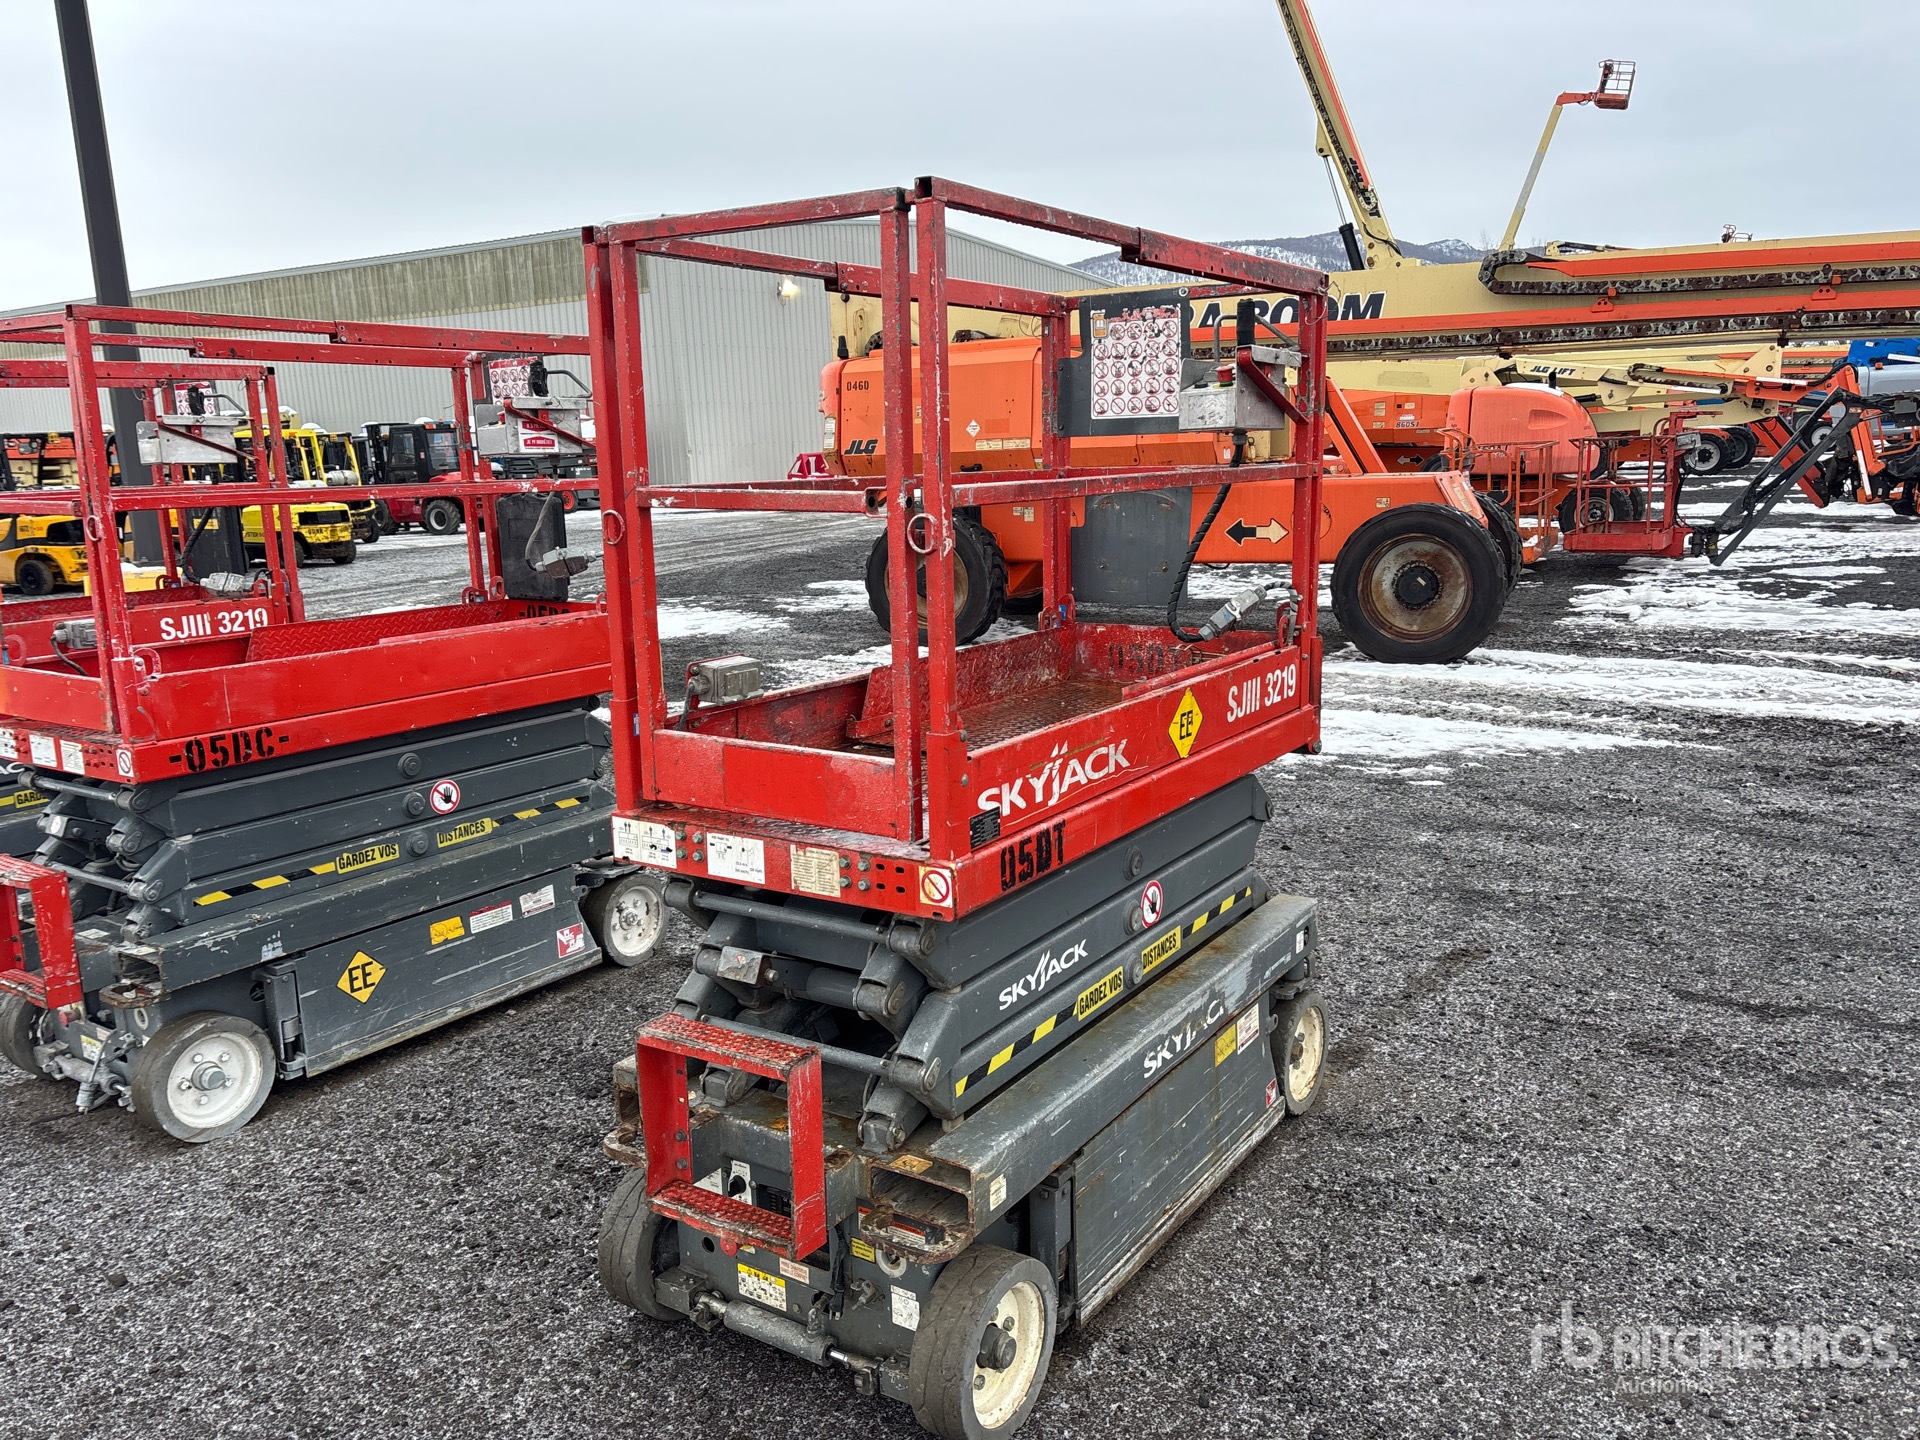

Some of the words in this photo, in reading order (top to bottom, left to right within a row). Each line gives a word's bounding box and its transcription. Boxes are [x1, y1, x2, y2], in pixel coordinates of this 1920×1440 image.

[844, 439, 879, 455] JLG
[217, 608, 268, 634] 3219
[1227, 676, 1261, 723] SJIII
[1264, 663, 1297, 707] 3219
[1178, 709, 1194, 741] EE
[977, 739, 1131, 817] SKYJACK
[338, 846, 376, 870] GARDEZ
[379, 843, 397, 859] VOS
[438, 820, 486, 845] DISTANCES
[347, 960, 376, 994] EE
[999, 938, 1089, 1011] SKYJACK
[1079, 981, 1108, 1016] GARDEZ
[1107, 971, 1123, 994] VOS
[1143, 933, 1177, 969] DISTANCES
